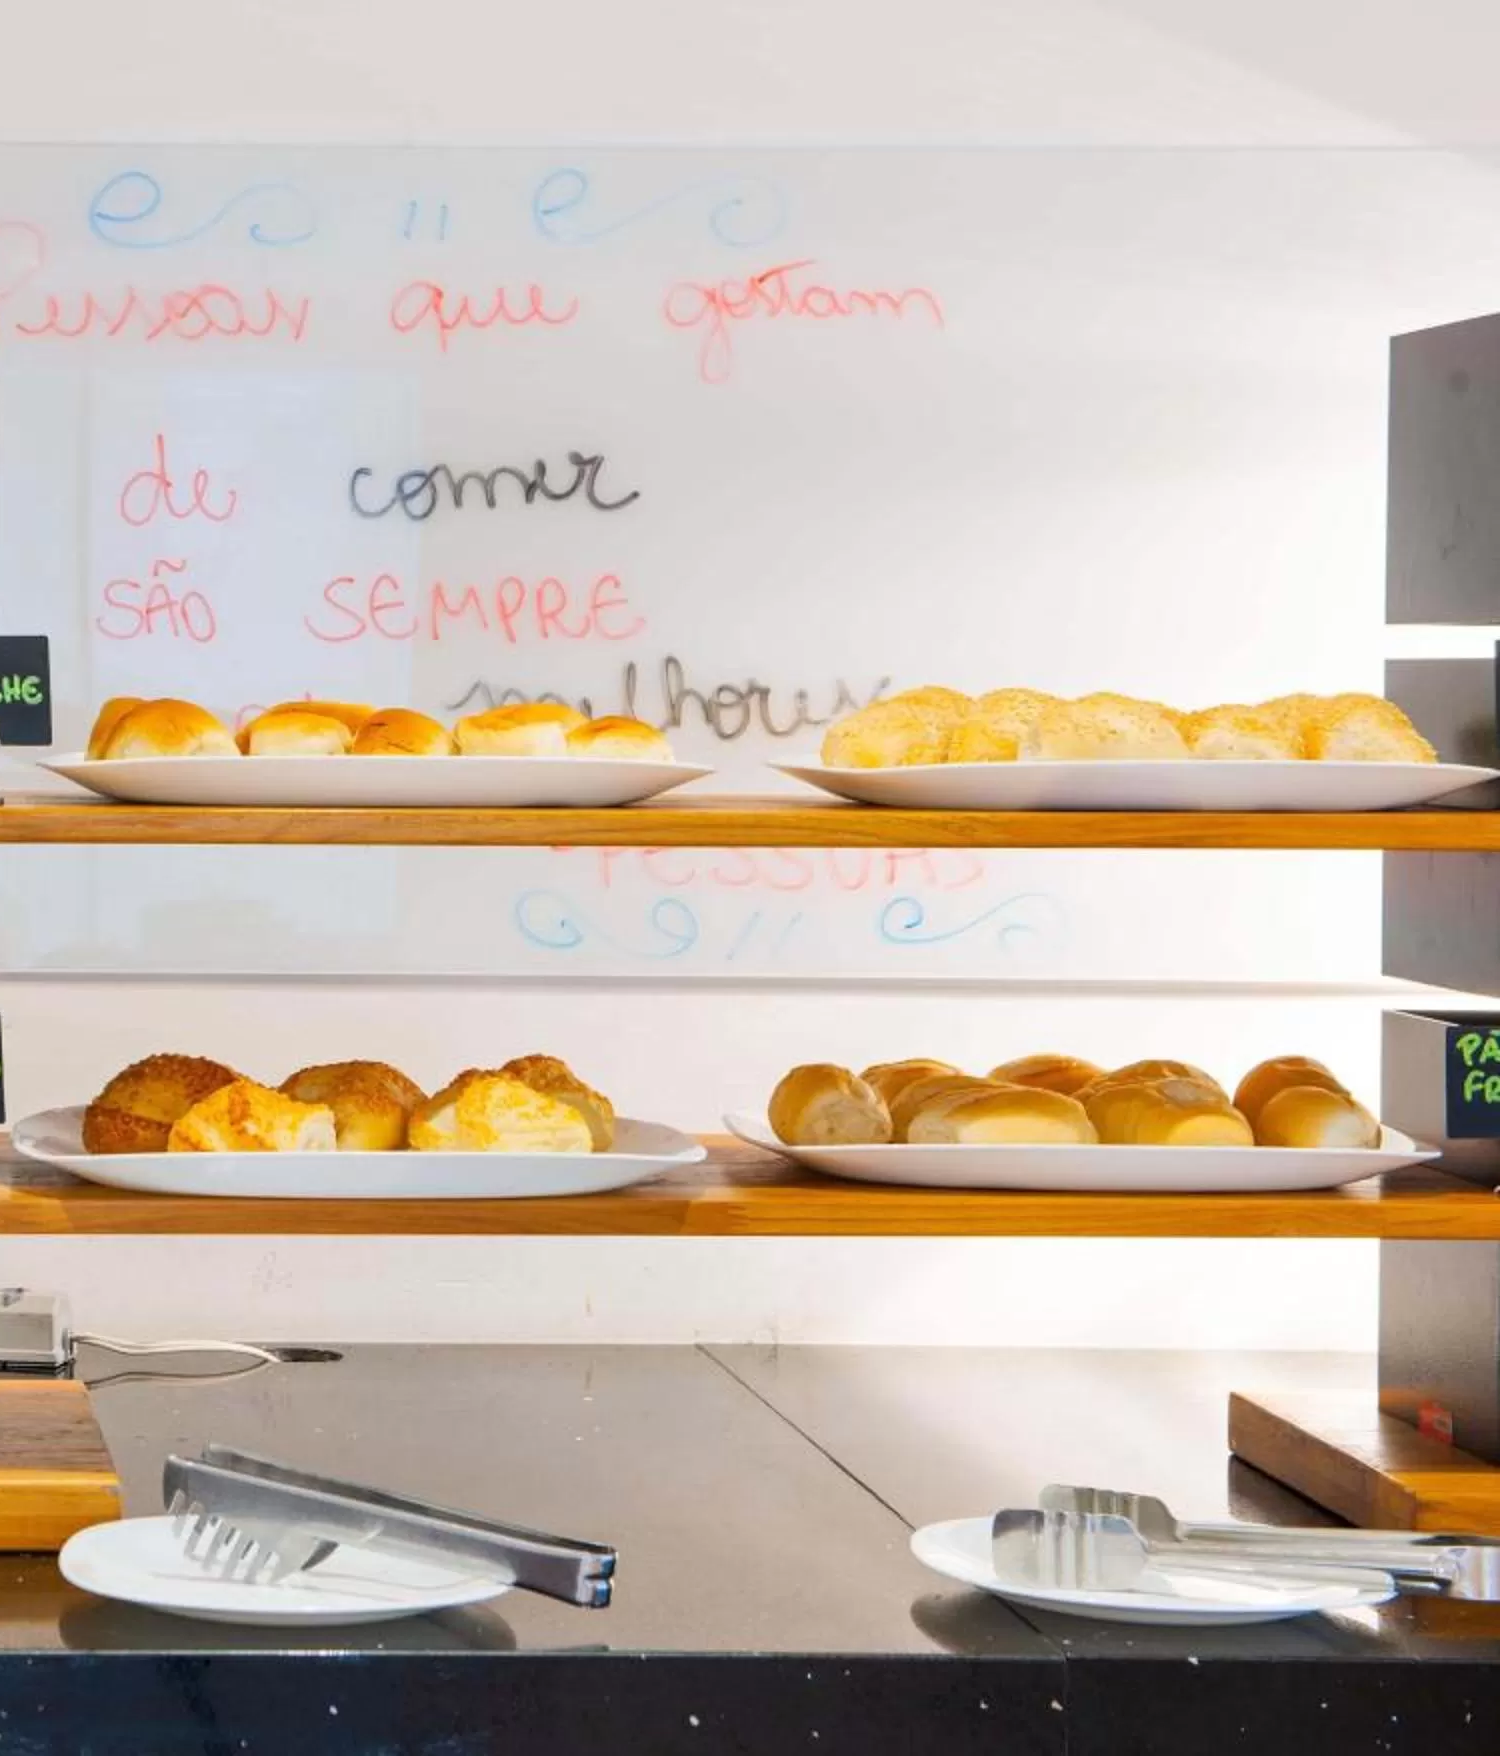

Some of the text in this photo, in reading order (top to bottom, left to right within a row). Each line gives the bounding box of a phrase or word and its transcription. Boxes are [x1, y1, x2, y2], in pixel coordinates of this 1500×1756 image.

[390, 280, 579, 354] que
[662, 259, 946, 386] gostam
[118, 432, 642, 527] de comer
[95, 558, 648, 645] SÃO SEMPRE
